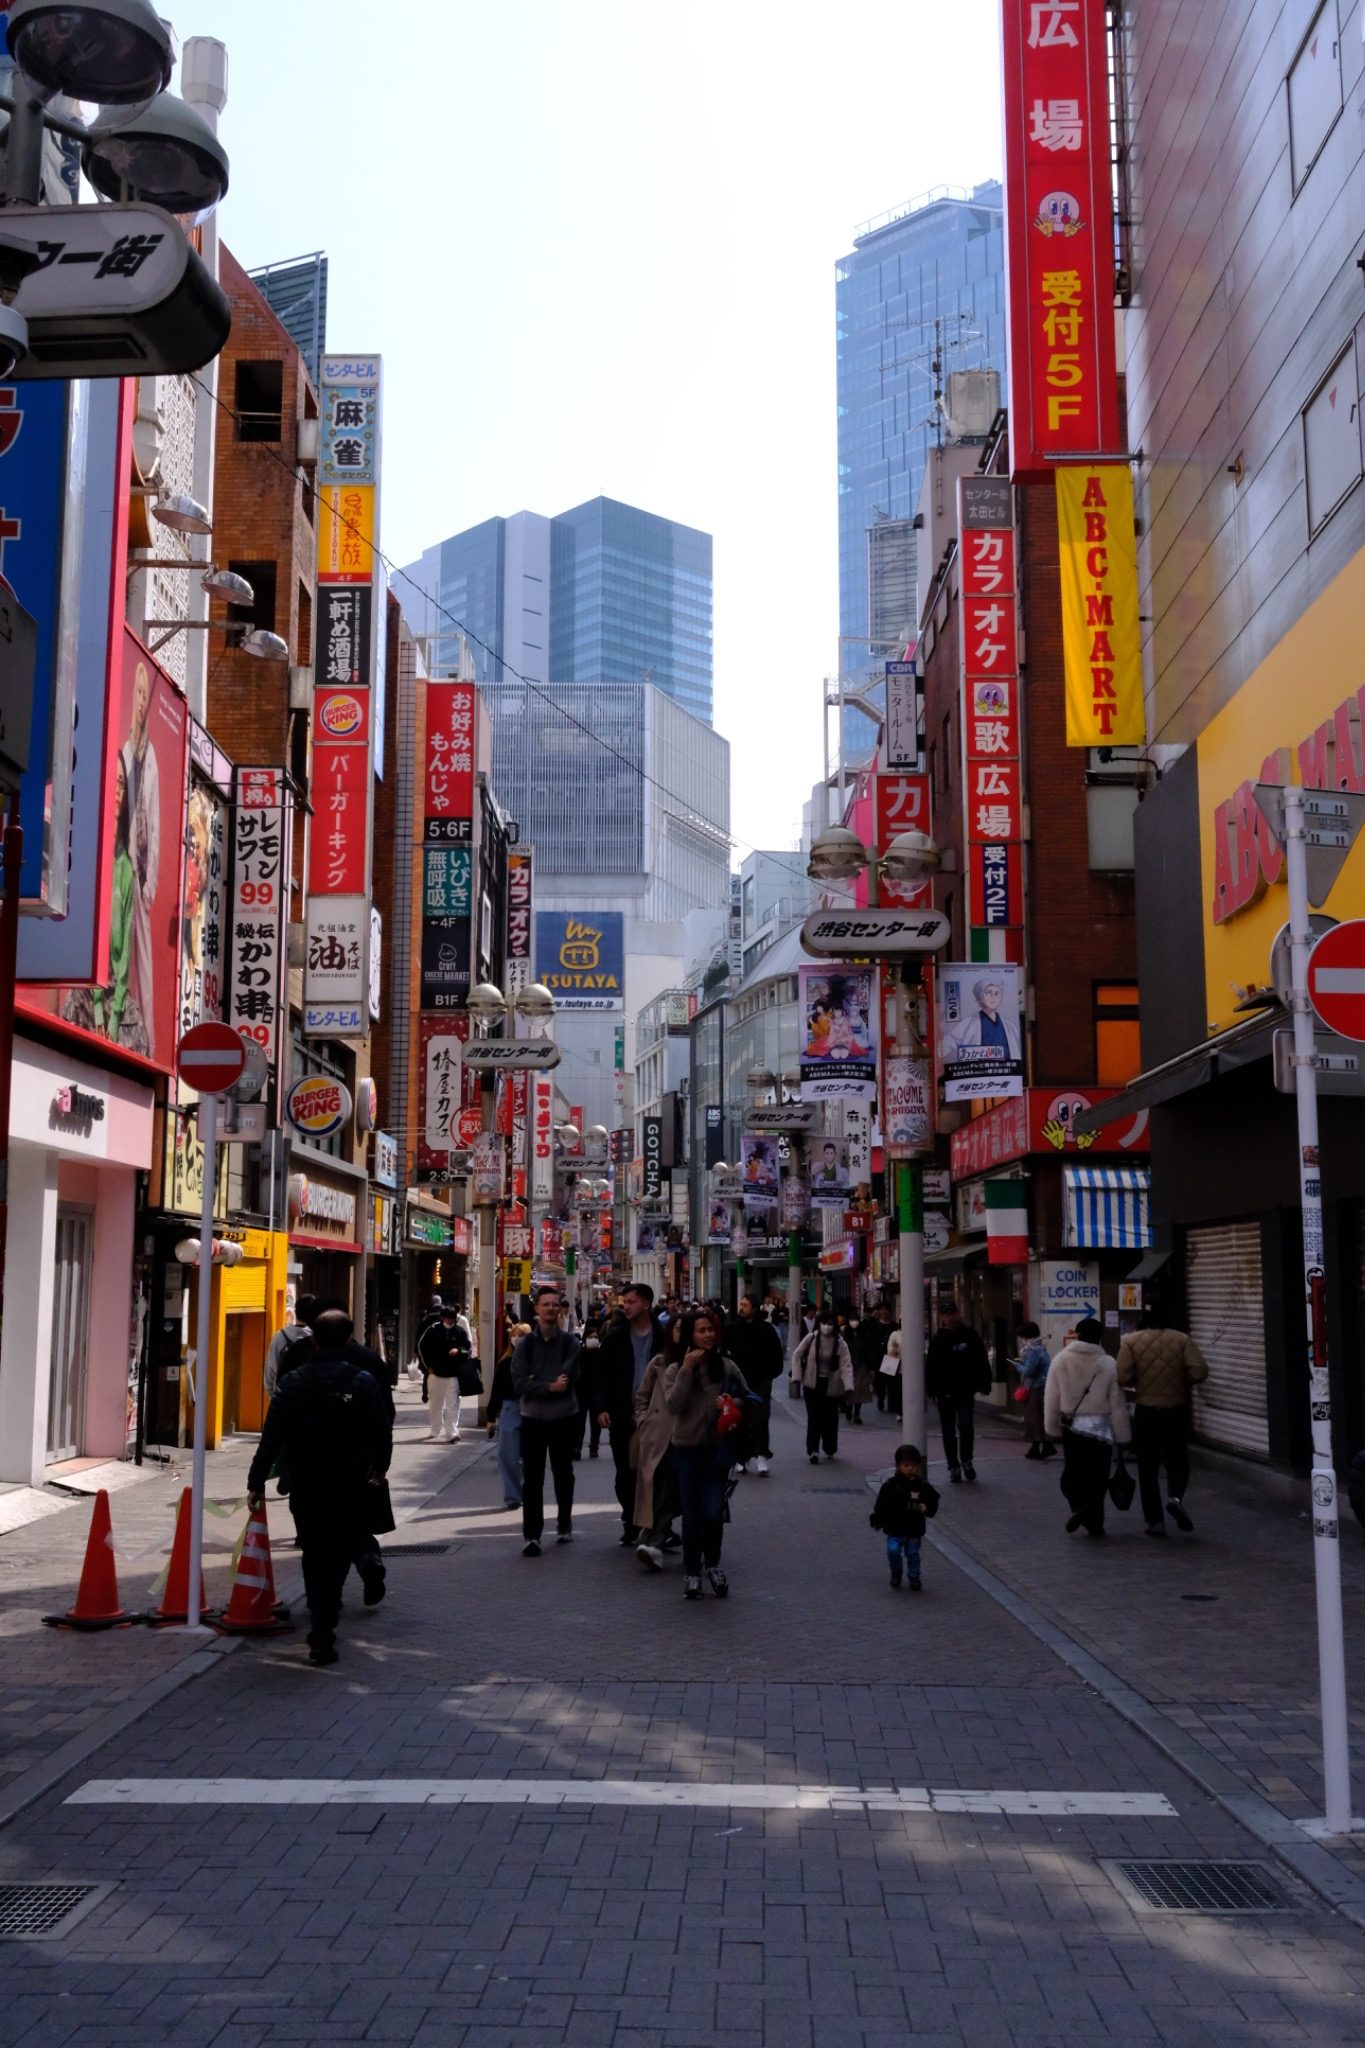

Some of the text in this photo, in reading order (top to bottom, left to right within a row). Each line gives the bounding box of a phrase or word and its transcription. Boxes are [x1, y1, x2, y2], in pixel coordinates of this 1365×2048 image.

[1027, 0, 1083, 152] 広場
[1041, 270, 1083, 430] 受付5F
[325, 364, 376, 378] センタービル
[360, 388, 376, 398] 5F
[334, 400, 363, 466] 麻雀
[965, 489, 1008, 500] センター街
[969, 505, 1006, 519] 太田ビル
[972, 533, 1007, 669] カラオケ
[326, 591, 353, 683] 一軒め酒場
[889, 664, 912, 673] CBR
[326, 703, 357, 718] BURGER
[327, 709, 358, 727] KING
[891, 677, 903, 750] モニタールーム
[450, 692, 472, 773] お好み焼
[429, 732, 449, 811] もんじゃ
[974, 722, 1011, 838] 歌広場
[327, 755, 349, 888] バーガーキング
[237, 815, 259, 882] サワー
[259, 811, 279, 880] レモン
[427, 851, 447, 906] 無呼吸
[450, 852, 470, 906] いびき
[984, 846, 1008, 924] 受付2F
[240, 883, 273, 905] 99
[236, 922, 275, 938] 秘伝
[440, 917, 456, 928] 4F
[813, 921, 941, 938] 渋谷センター街
[236, 942, 271, 1021] かわ串
[509, 962, 517, 995] ルノアー
[541, 974, 618, 989] TSUTAYA
[435, 995, 459, 1006] B1F
[307, 1010, 360, 1027] センタービル
[466, 1046, 554, 1059] 渋谷センター街
[293, 1086, 340, 1108] BURGER
[431, 1047, 458, 1138] 椿屋カフェ
[812, 1083, 865, 1093] 渋谷センター街
[956, 1081, 1010, 1093] 渋谷センター街
[293, 1100, 341, 1123] KING
[748, 1113, 813, 1122] 渋谷センター街
[647, 1123, 659, 1199] GOTCHA
[851, 1216, 864, 1227] B1
[505, 1228, 528, 1256] 豚
[1056, 1270, 1087, 1282] COIN
[1048, 1286, 1098, 1298] LOCKER
